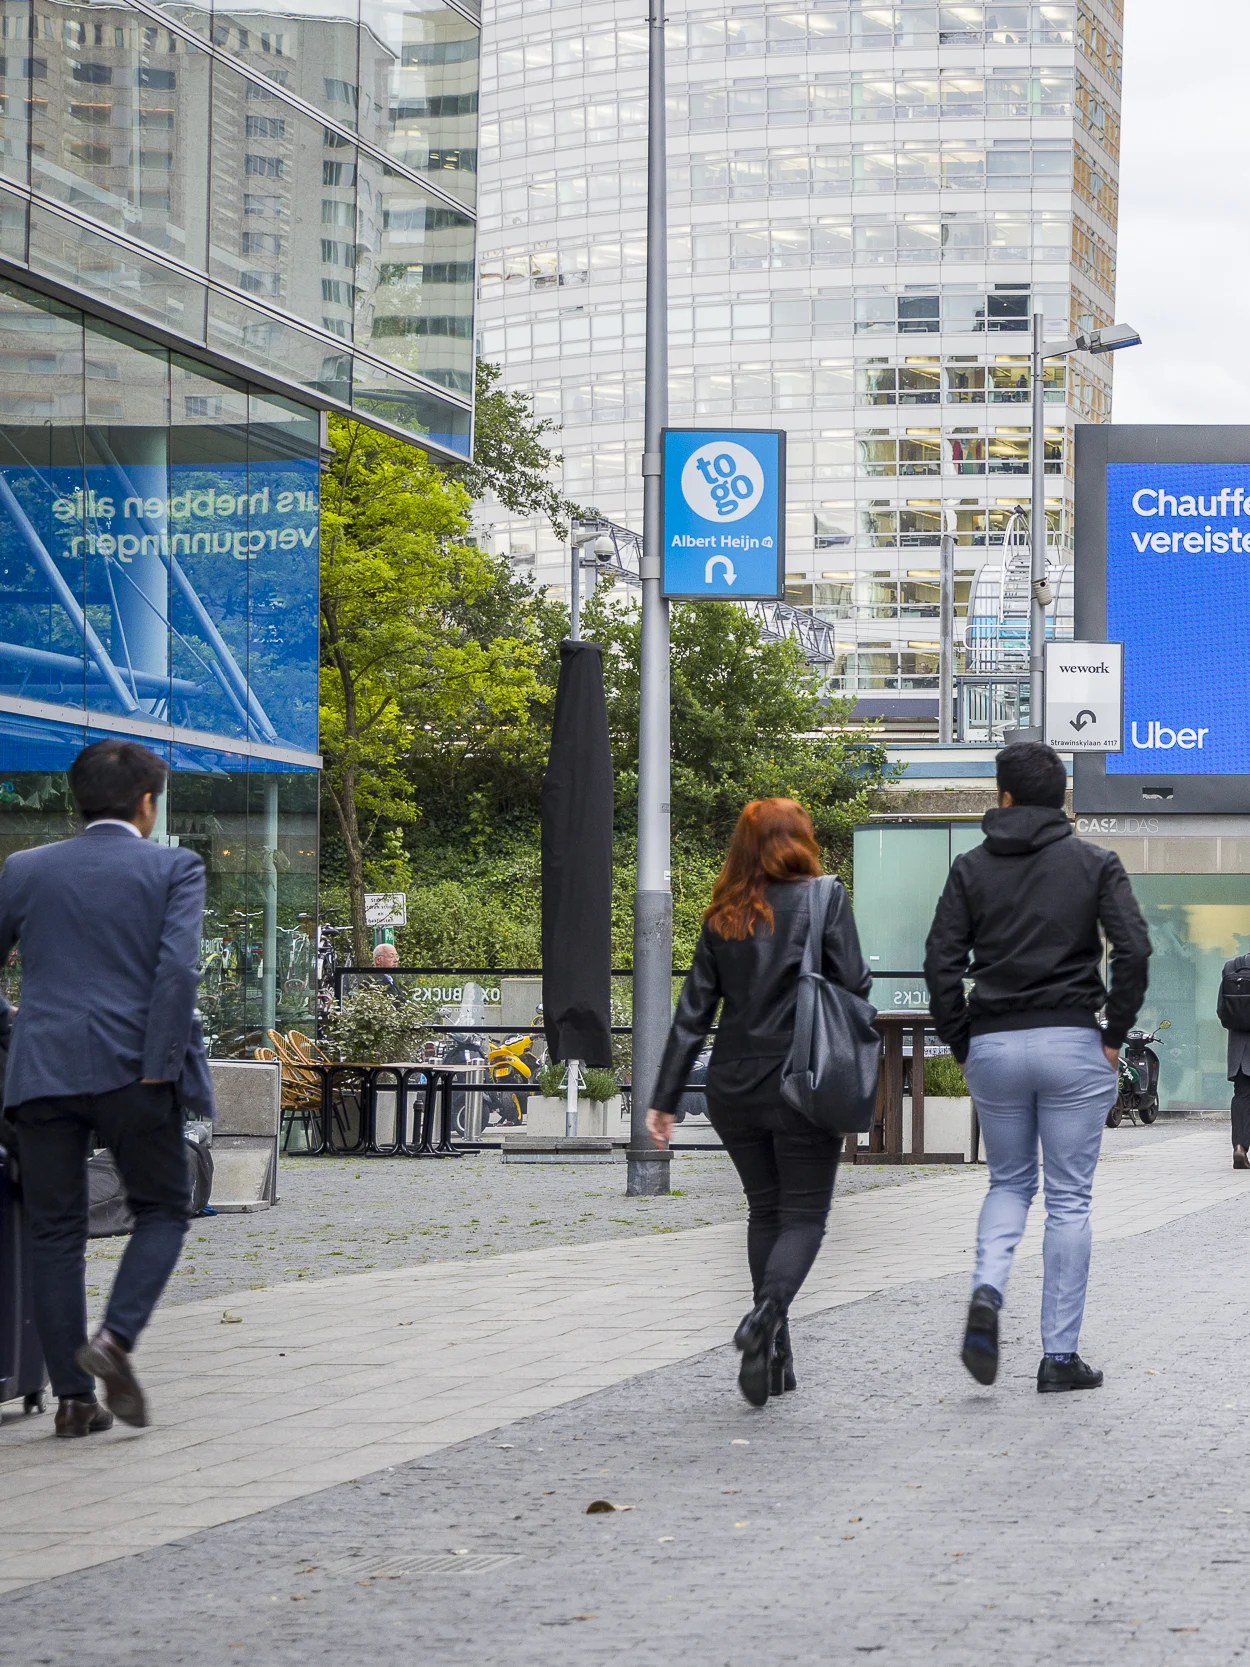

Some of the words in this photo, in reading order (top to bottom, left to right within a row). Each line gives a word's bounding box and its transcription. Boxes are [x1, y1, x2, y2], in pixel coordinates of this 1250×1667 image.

[695, 453, 737, 484] to
[710, 474, 754, 516] go
[671, 534, 717, 548] Albert
[720, 534, 760, 551] Heijn
[1059, 661, 1110, 674] wework
[1050, 739, 1102, 748] Strawinskylaan
[1103, 739, 1118, 747] 4117
[1131, 721, 1209, 750] Uber
